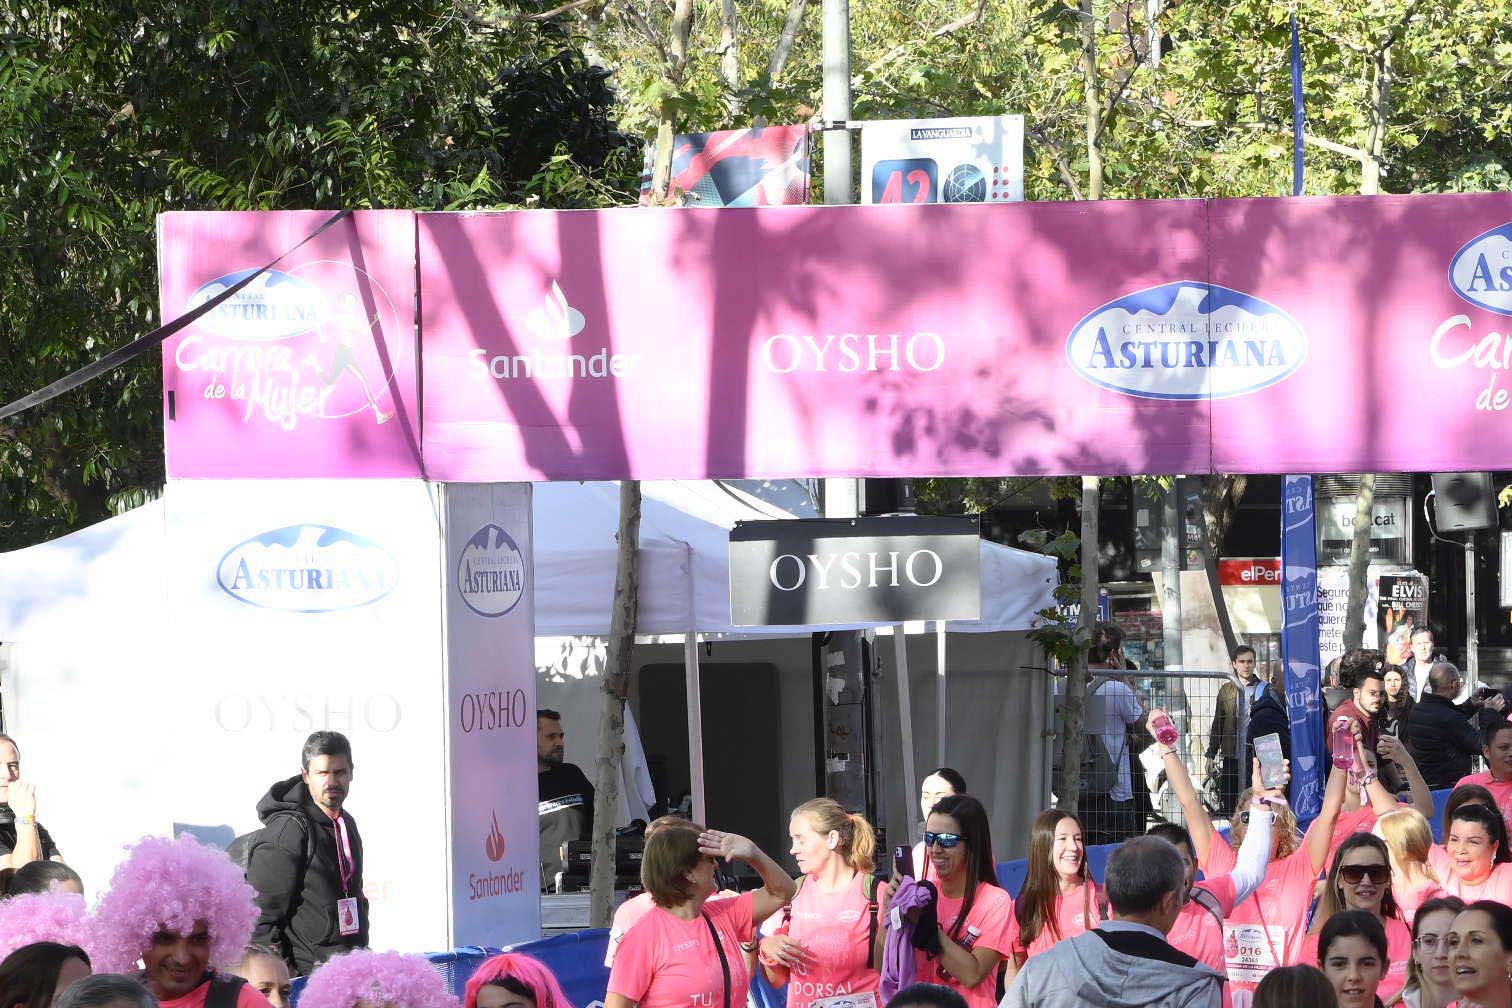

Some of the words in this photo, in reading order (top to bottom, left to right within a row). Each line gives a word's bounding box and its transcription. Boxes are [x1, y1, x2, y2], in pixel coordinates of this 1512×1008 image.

[923, 127, 973, 138] VANGUARDIA
[1121, 322, 1197, 335] CENTRAL
[764, 332, 946, 374] OYSHO
[1087, 325, 1289, 369] ASTURIANA
[469, 347, 643, 380] Santander
[1475, 374, 1511, 412] de
[231, 556, 389, 591] ASTURIANA
[463, 558, 521, 595] ASTURIANA
[769, 549, 943, 592] OYSHO
[1240, 566, 1281, 582] elPer
[1392, 585, 1423, 598] ELVIS
[1317, 603, 1334, 613] que
[1319, 641, 1338, 651] este
[213, 689, 404, 733] OYSHO
[459, 688, 528, 734] OYSHO
[468, 870, 525, 901] Santander
[1240, 946, 1262, 956] 016
[690, 992, 713, 1007] TU
